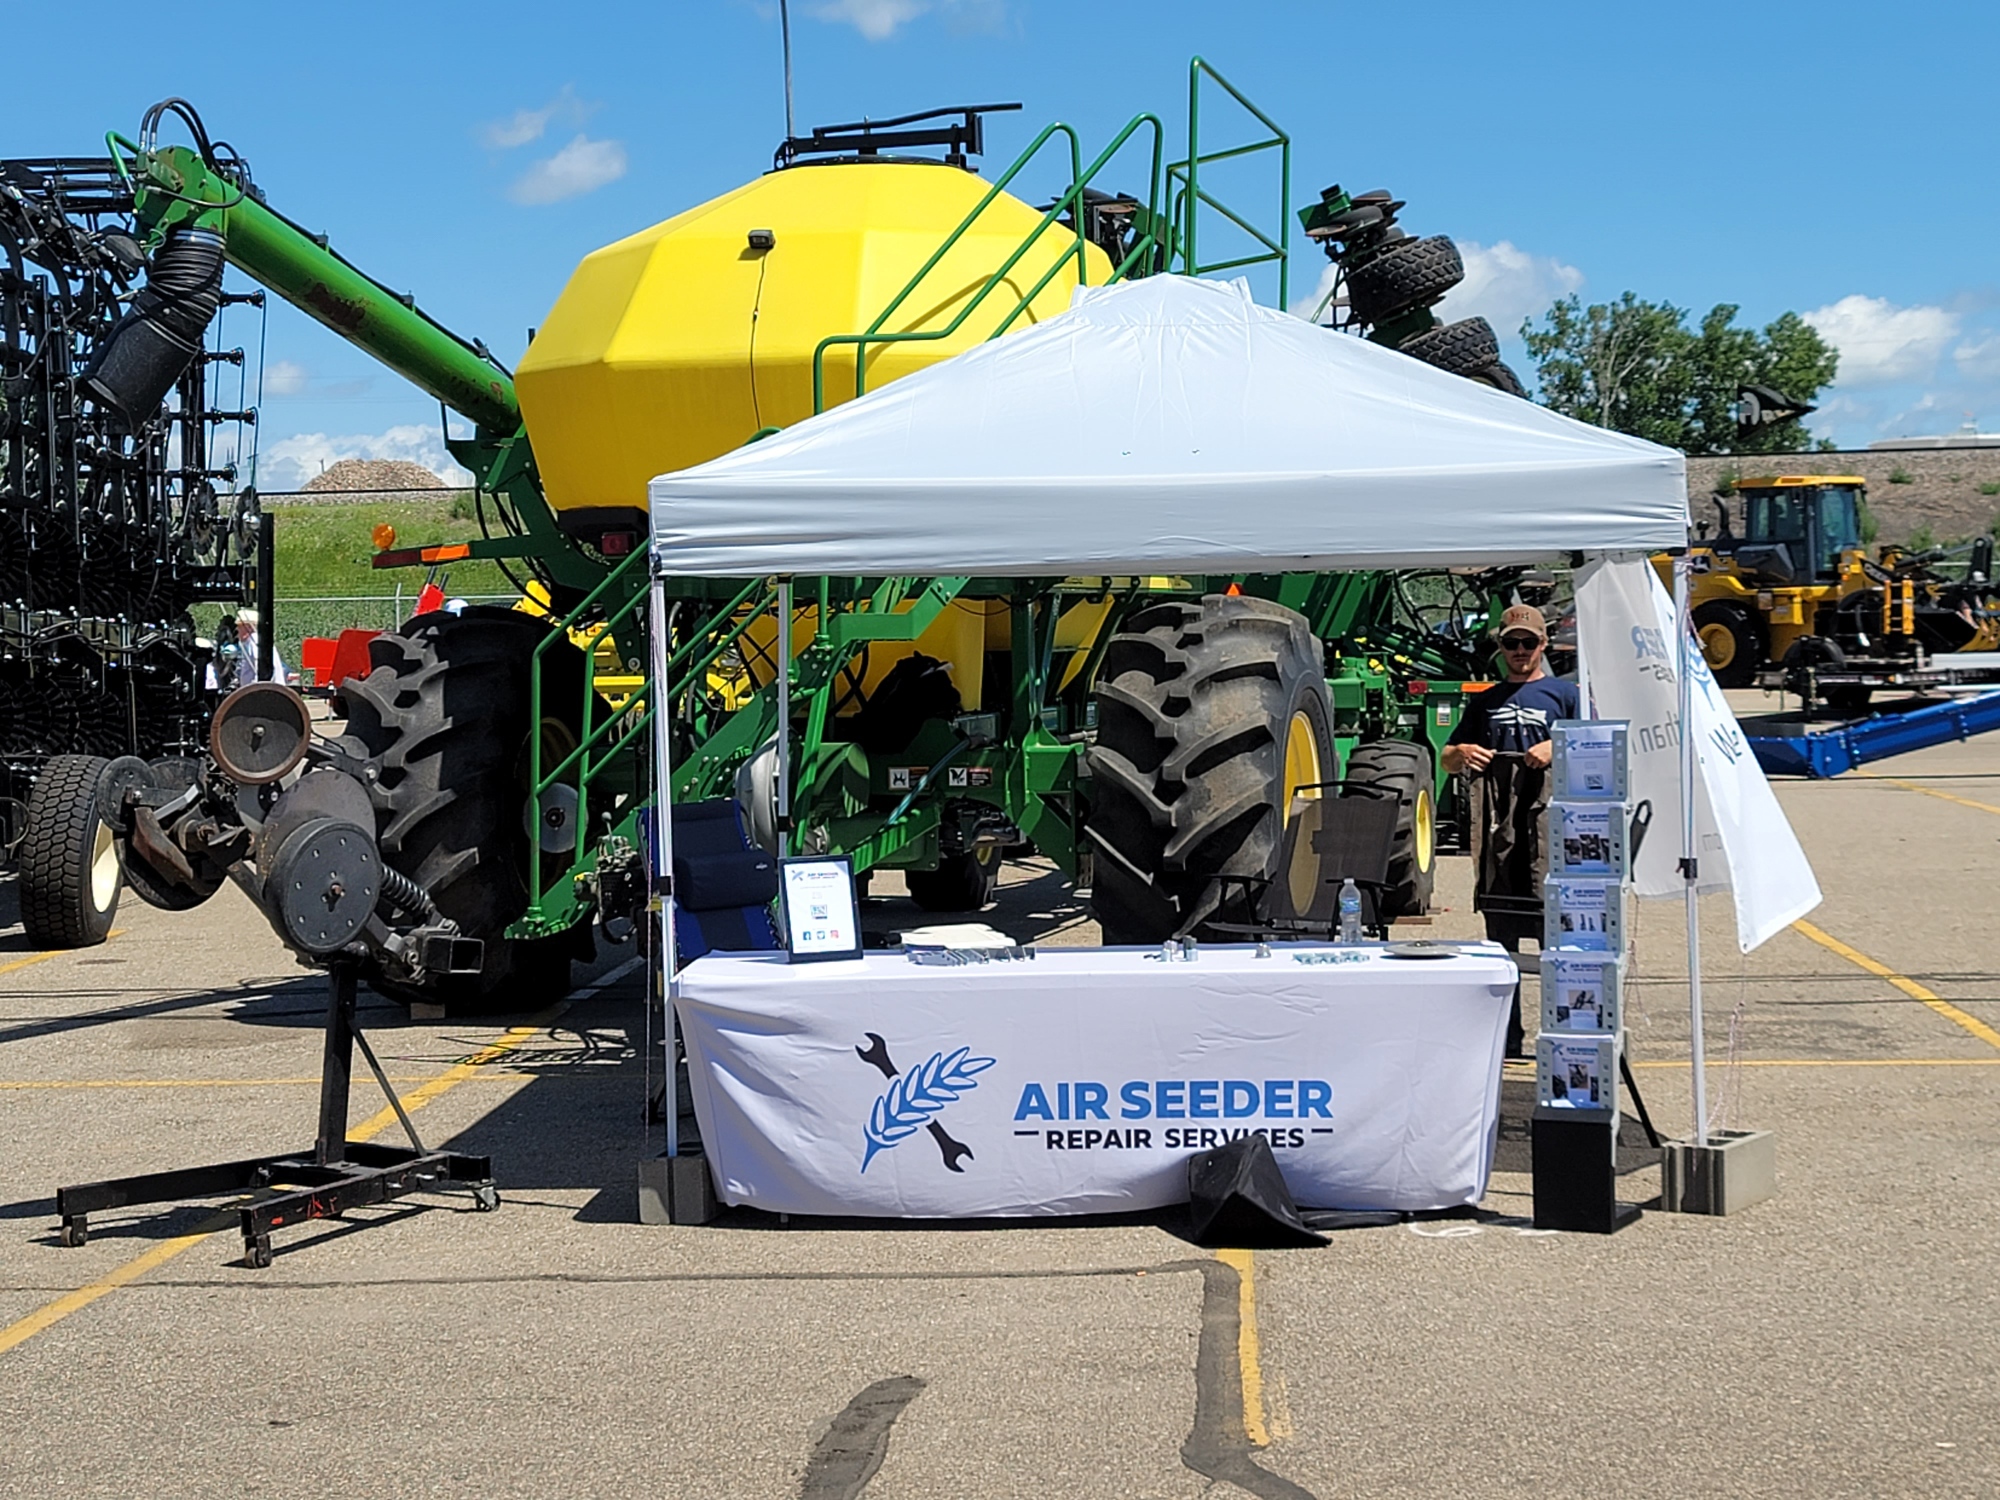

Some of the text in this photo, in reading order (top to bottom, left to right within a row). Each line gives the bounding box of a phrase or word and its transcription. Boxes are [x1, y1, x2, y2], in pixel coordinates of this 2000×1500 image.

[1013, 1080, 1334, 1121] AIR SEEDER
[1047, 1129, 1152, 1149] REPAIR
